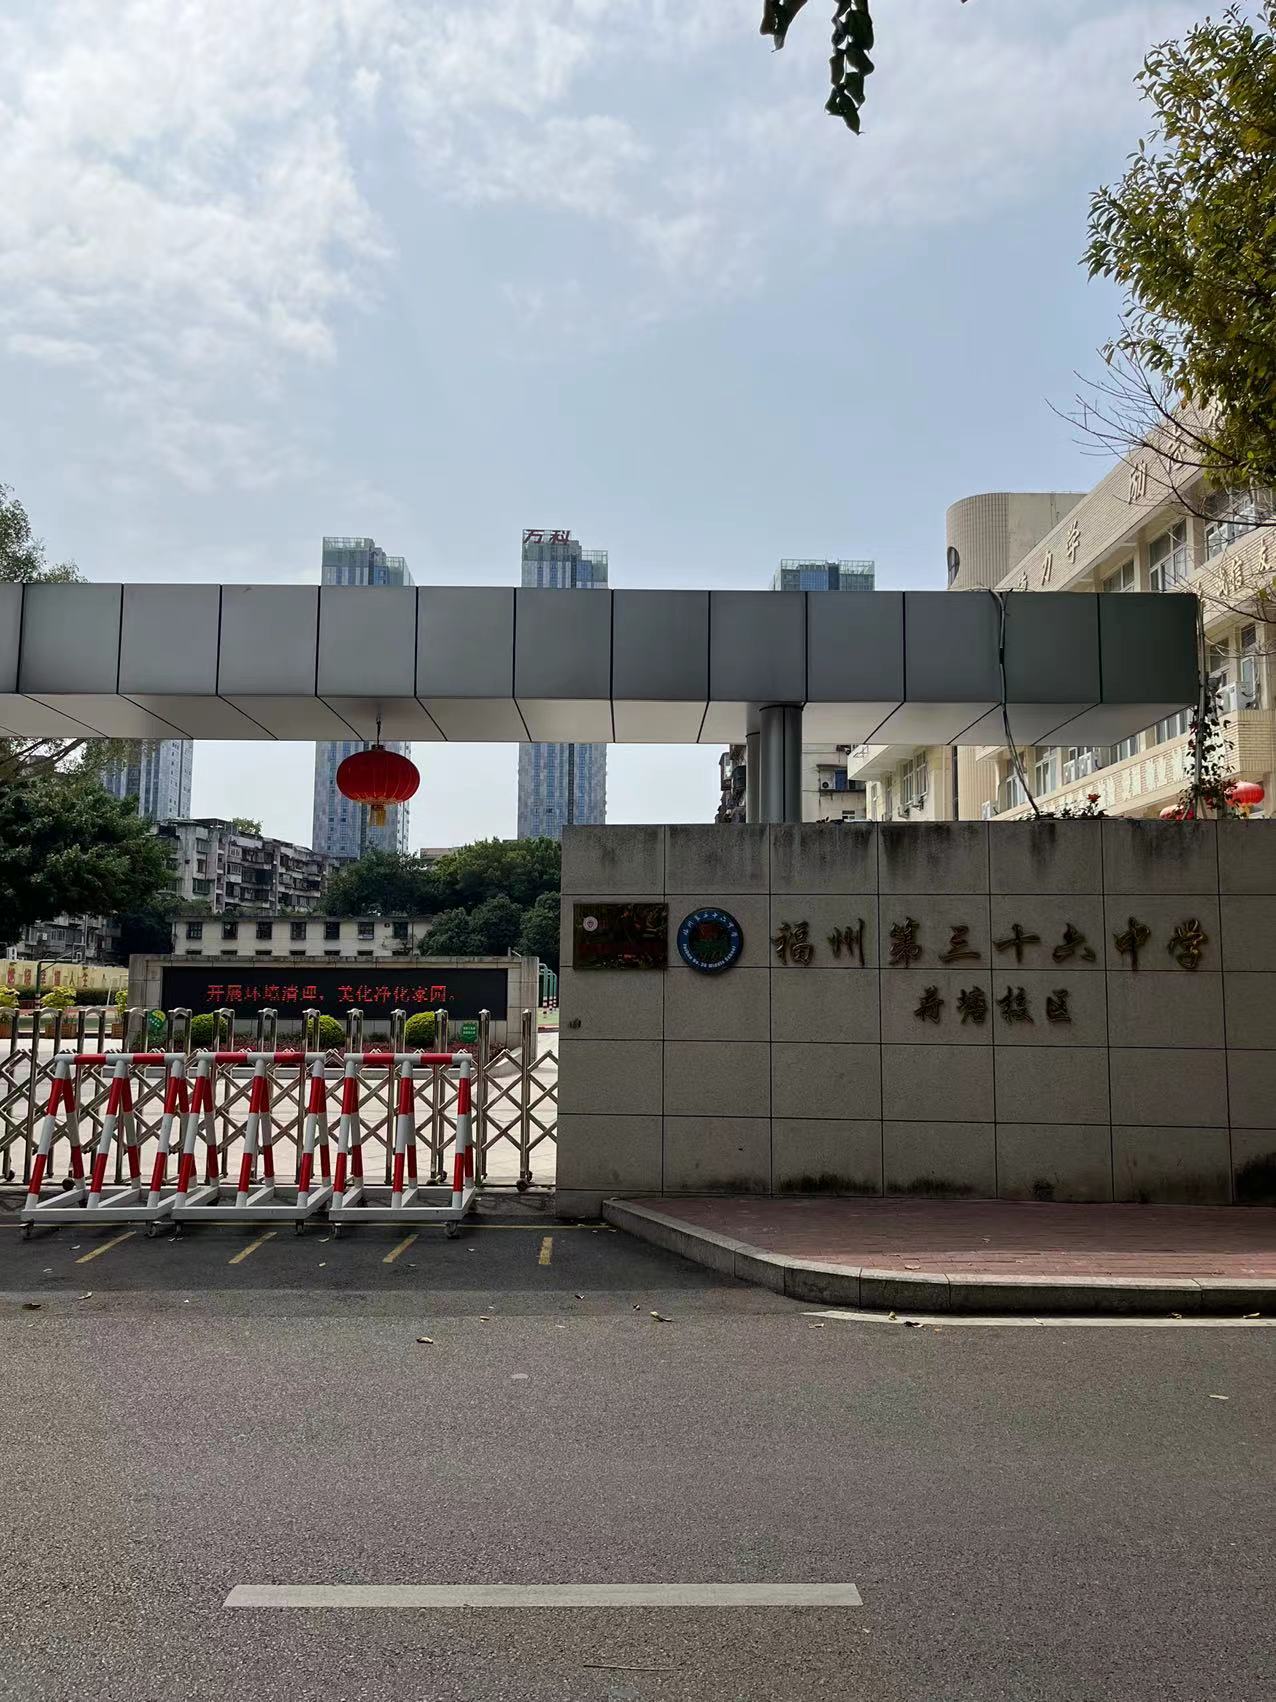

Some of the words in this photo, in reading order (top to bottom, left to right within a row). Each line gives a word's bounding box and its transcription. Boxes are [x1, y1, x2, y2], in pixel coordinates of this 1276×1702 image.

[522, 529, 571, 545] 万科
[770, 916, 1208, 971] 福州第三十六中学
